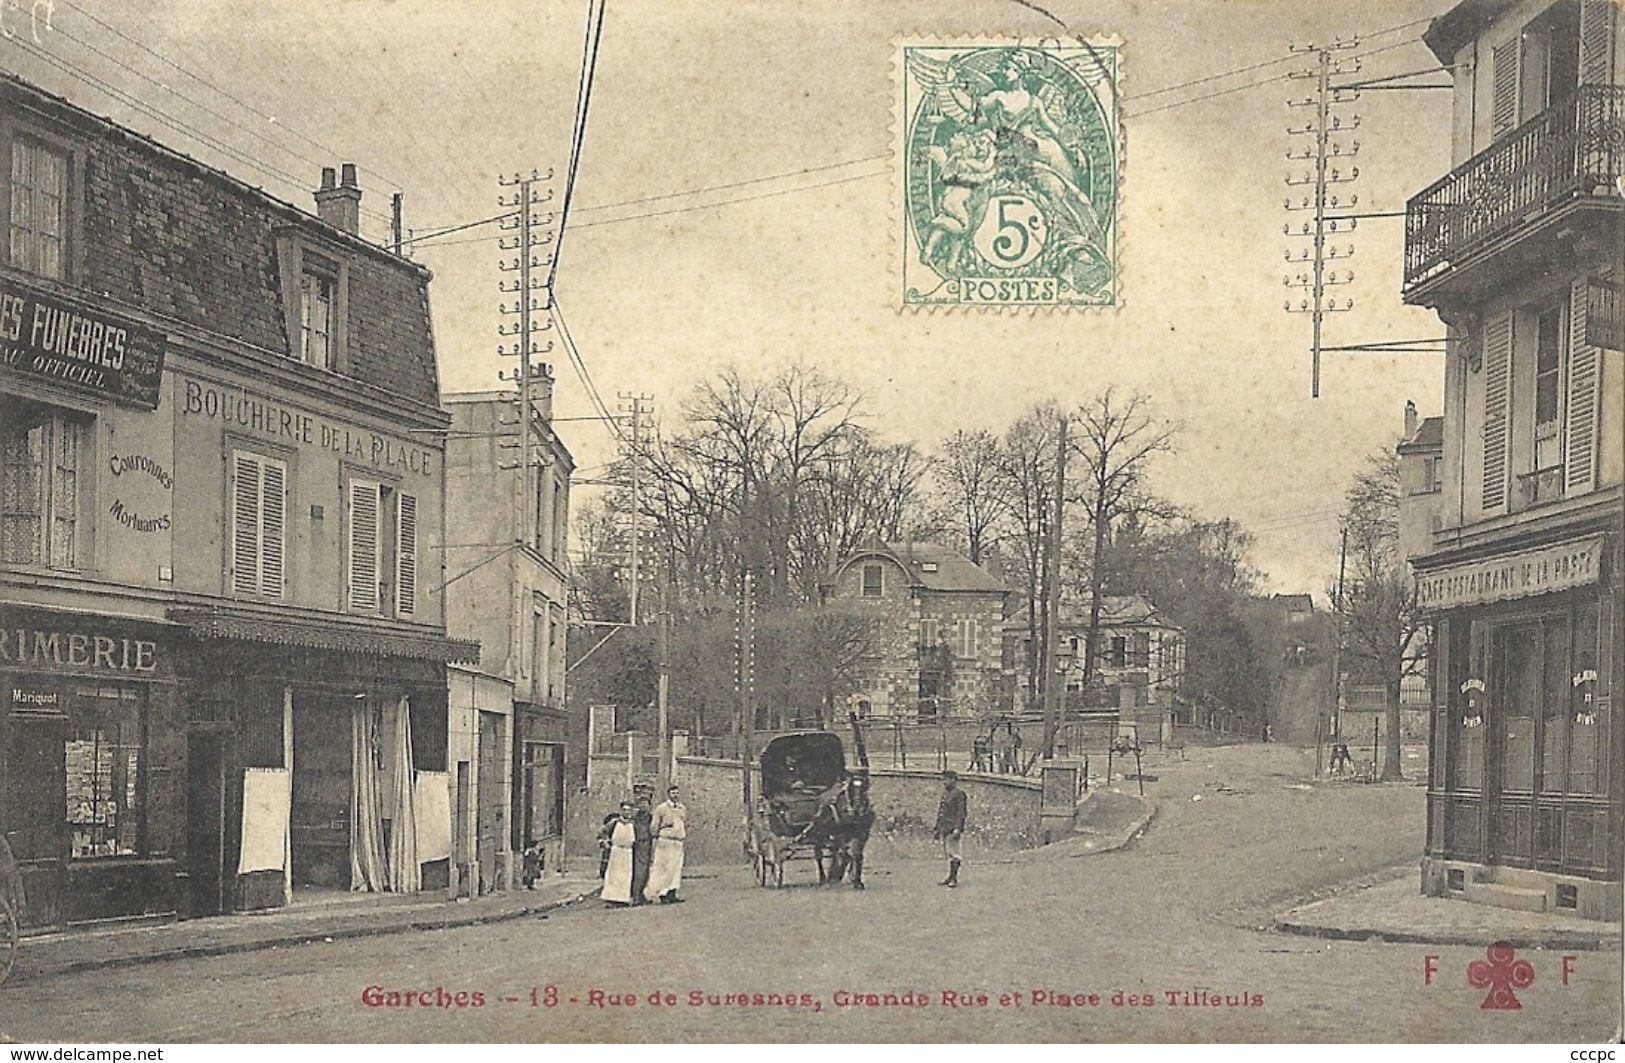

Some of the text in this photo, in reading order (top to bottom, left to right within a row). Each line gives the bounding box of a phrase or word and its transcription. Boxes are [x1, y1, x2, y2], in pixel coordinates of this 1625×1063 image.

[963, 280, 1053, 302] POSTES
[33, 355, 105, 388] OFFICIEL
[183, 379, 431, 476] BOUCHERIE DE LA PLACE
[110, 454, 174, 489] Couronnes
[109, 499, 171, 532] Mortuaires
[1447, 565, 1515, 598] RESTAURANT
[1521, 562, 1531, 588] DE
[1537, 559, 1547, 585] LA
[1554, 549, 1594, 582] POSTE
